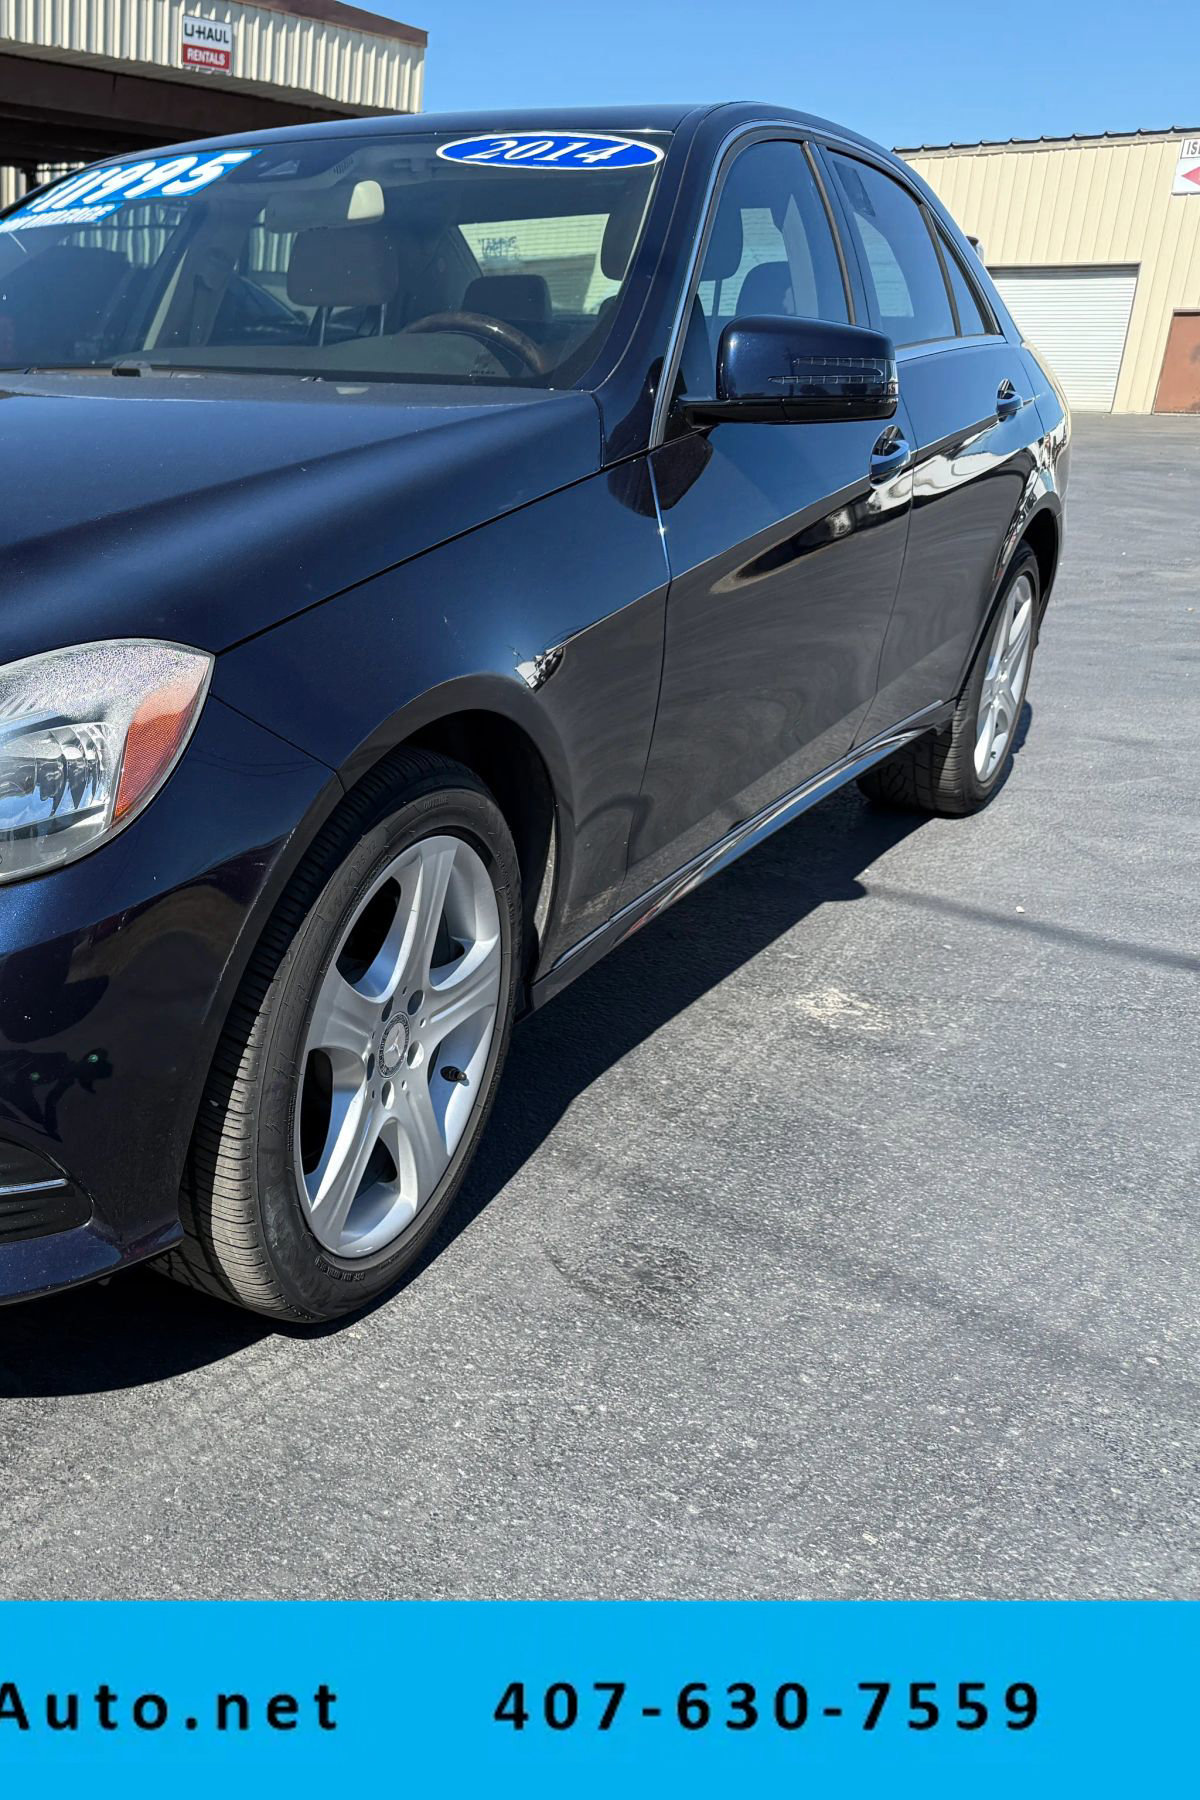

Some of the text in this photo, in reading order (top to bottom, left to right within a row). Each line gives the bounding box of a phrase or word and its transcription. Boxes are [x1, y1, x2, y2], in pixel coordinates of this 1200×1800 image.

[184, 24, 229, 44] U-HAUL
[187, 48, 225, 66] RENTALS
[466, 140, 631, 164] 2014
